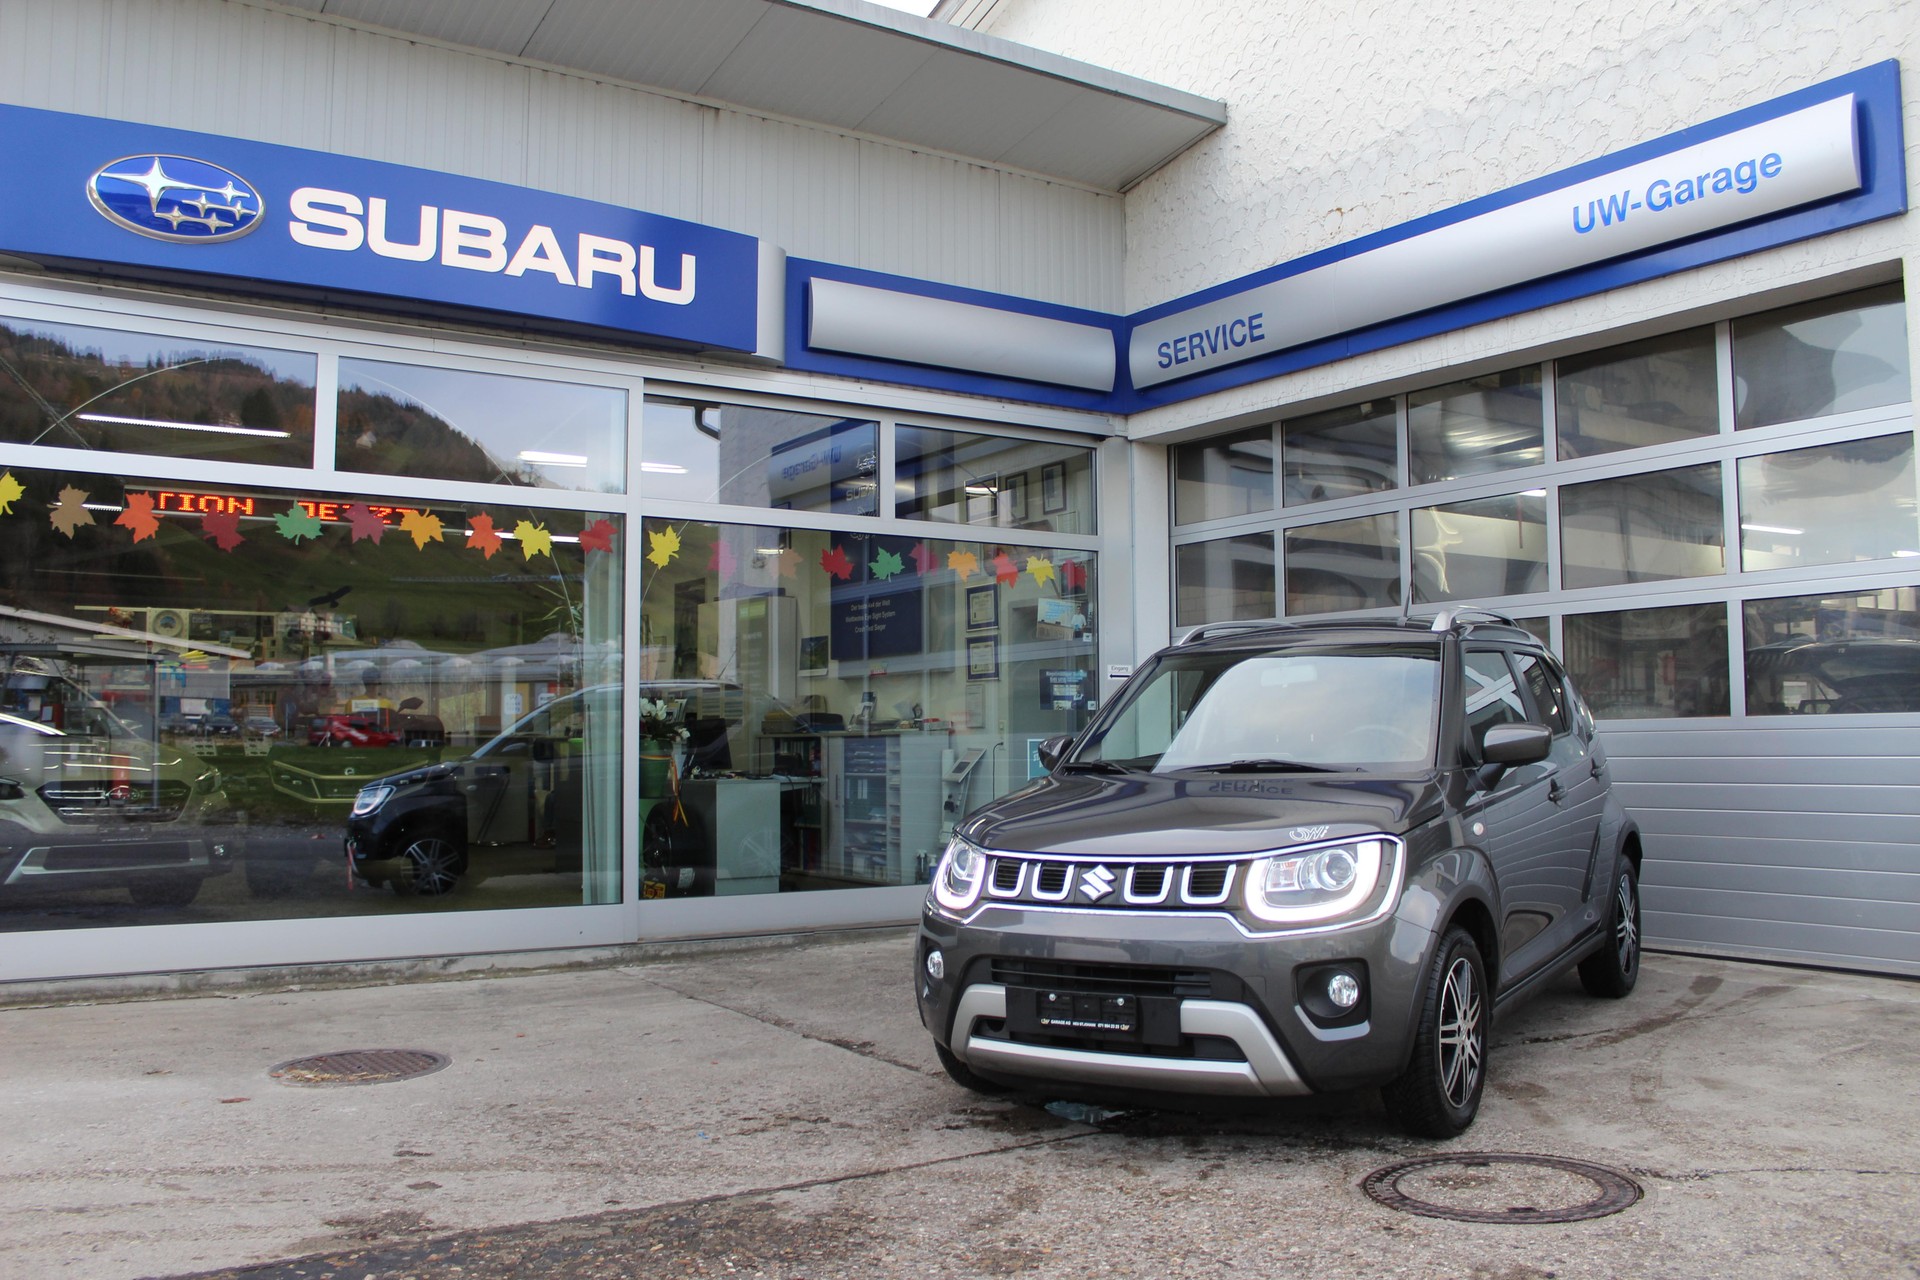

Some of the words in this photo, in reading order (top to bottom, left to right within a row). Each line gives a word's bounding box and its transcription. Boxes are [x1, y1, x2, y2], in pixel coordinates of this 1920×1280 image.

[1573, 152, 1782, 234] UW-Garage
[289, 186, 696, 305] SUBARU
[1157, 312, 1265, 369] SERVICE
